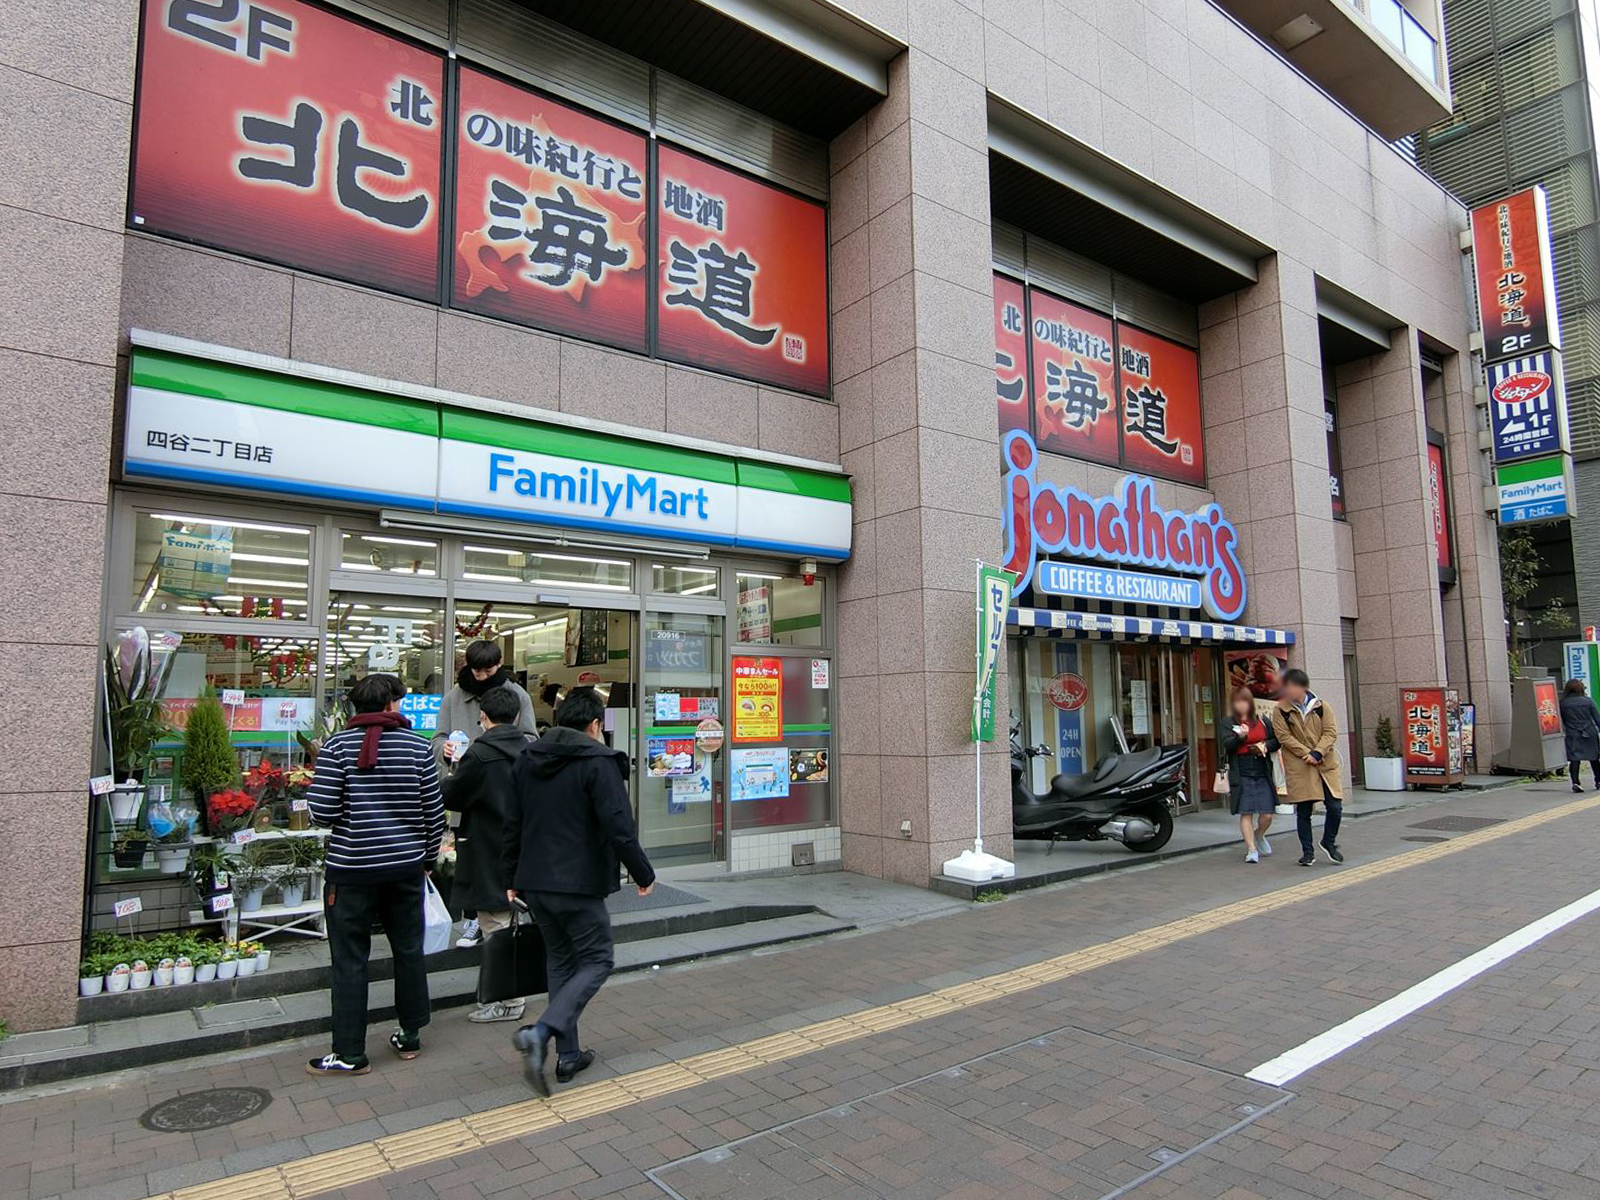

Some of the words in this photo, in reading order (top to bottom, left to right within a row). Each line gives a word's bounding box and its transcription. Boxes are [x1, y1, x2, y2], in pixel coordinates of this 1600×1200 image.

[167, 0, 297, 60] 2F
[1498, 272, 1528, 325] 北海道
[1501, 333, 1532, 353] 2F
[1529, 413, 1552, 428] 1F
[147, 430, 273, 463] 四谷二丁目店
[488, 452, 709, 519] FamilyMart
[1501, 481, 1563, 499] FamilyMart
[1529, 505, 1554, 518] たばこ
[1001, 433, 1244, 618] jonathan's
[1050, 567, 1102, 595] COFFEE
[1105, 574, 1115, 595] &
[1117, 575, 1193, 604] RESTAURANT
[656, 632, 680, 640] 20916
[1062, 729, 1079, 740] 24H
[1409, 706, 1434, 756] 北海道
[1061, 746, 1082, 759] OPEN
